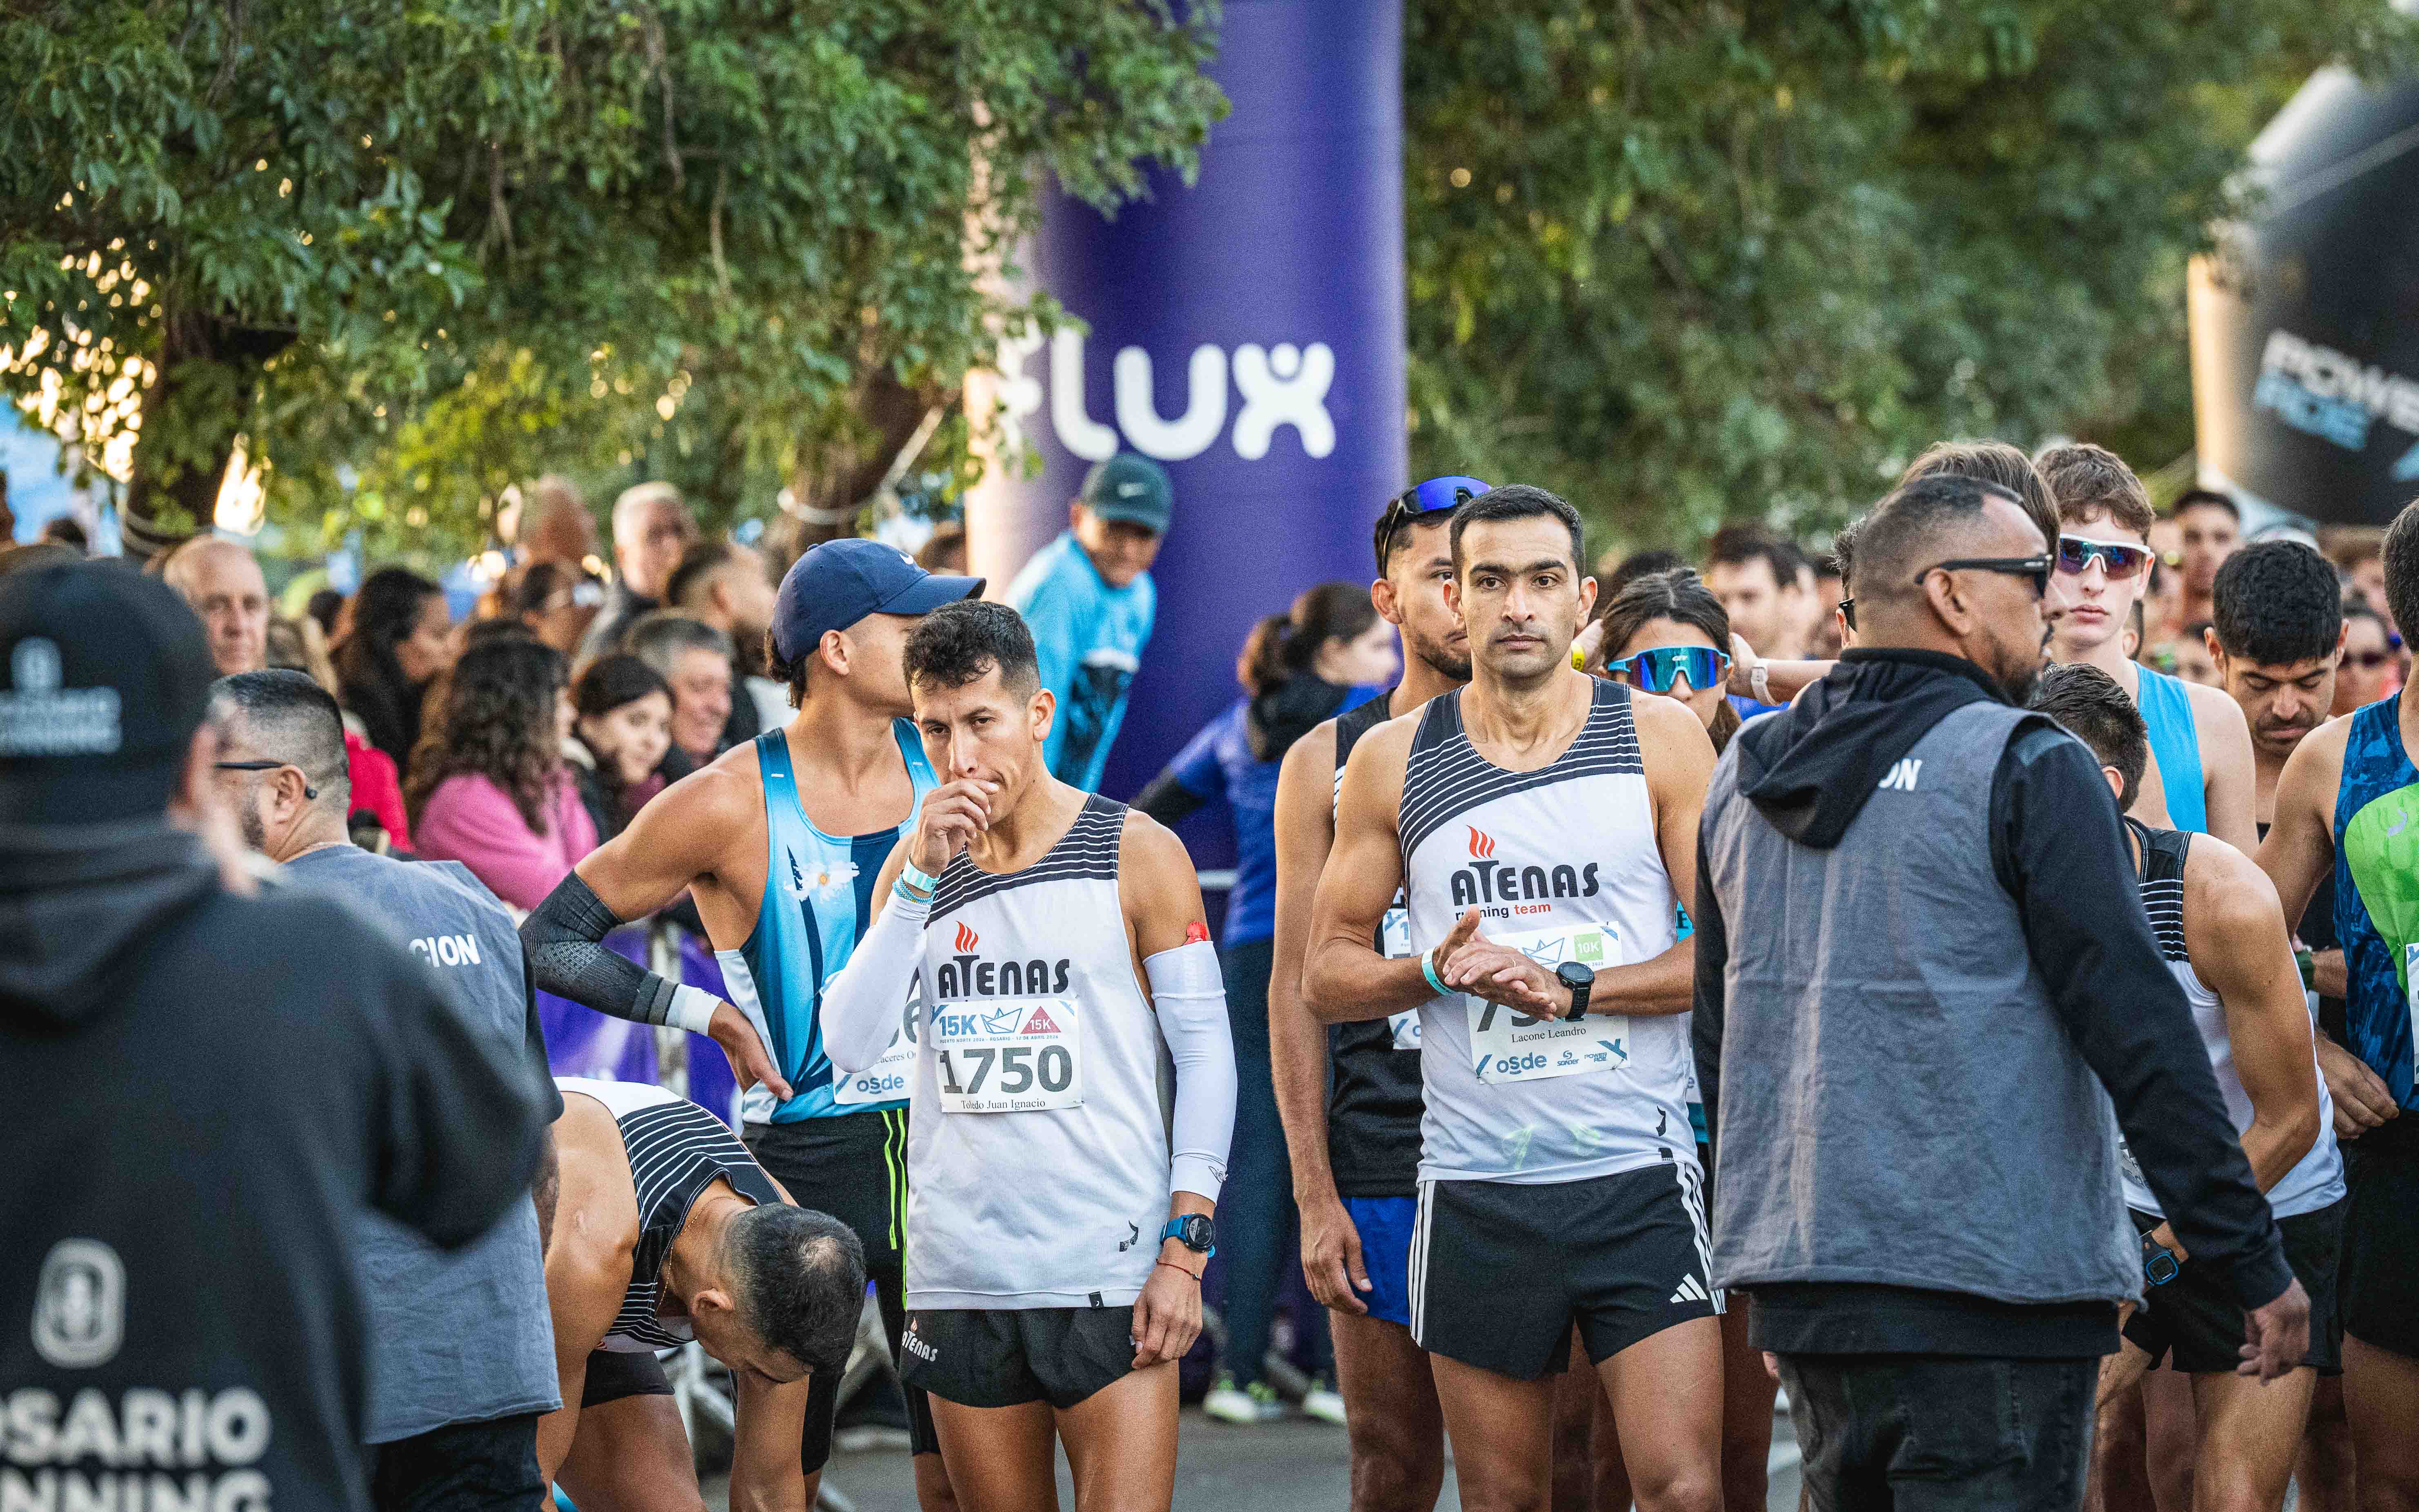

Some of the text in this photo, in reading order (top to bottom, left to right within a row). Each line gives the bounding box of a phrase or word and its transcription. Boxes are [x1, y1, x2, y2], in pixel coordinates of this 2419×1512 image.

[1451, 860, 1599, 906] ATENAS
[1455, 904, 1551, 921] rning team
[1577, 941, 1600, 954] 10K
[938, 955, 1070, 998] ATENAS
[940, 1015, 977, 1036] 15K
[1030, 1018, 1052, 1030] 15K
[1511, 1026, 1586, 1043] Lacone Leandro
[940, 1045, 1072, 1094] 1750
[1496, 1052, 1547, 1075] osde
[857, 1072, 904, 1094] osde
[961, 1098, 1046, 1110] Toledo Juan Ignacio
[901, 1330, 938, 1362] ATENAS
[0, 1387, 273, 1467] SARIO
